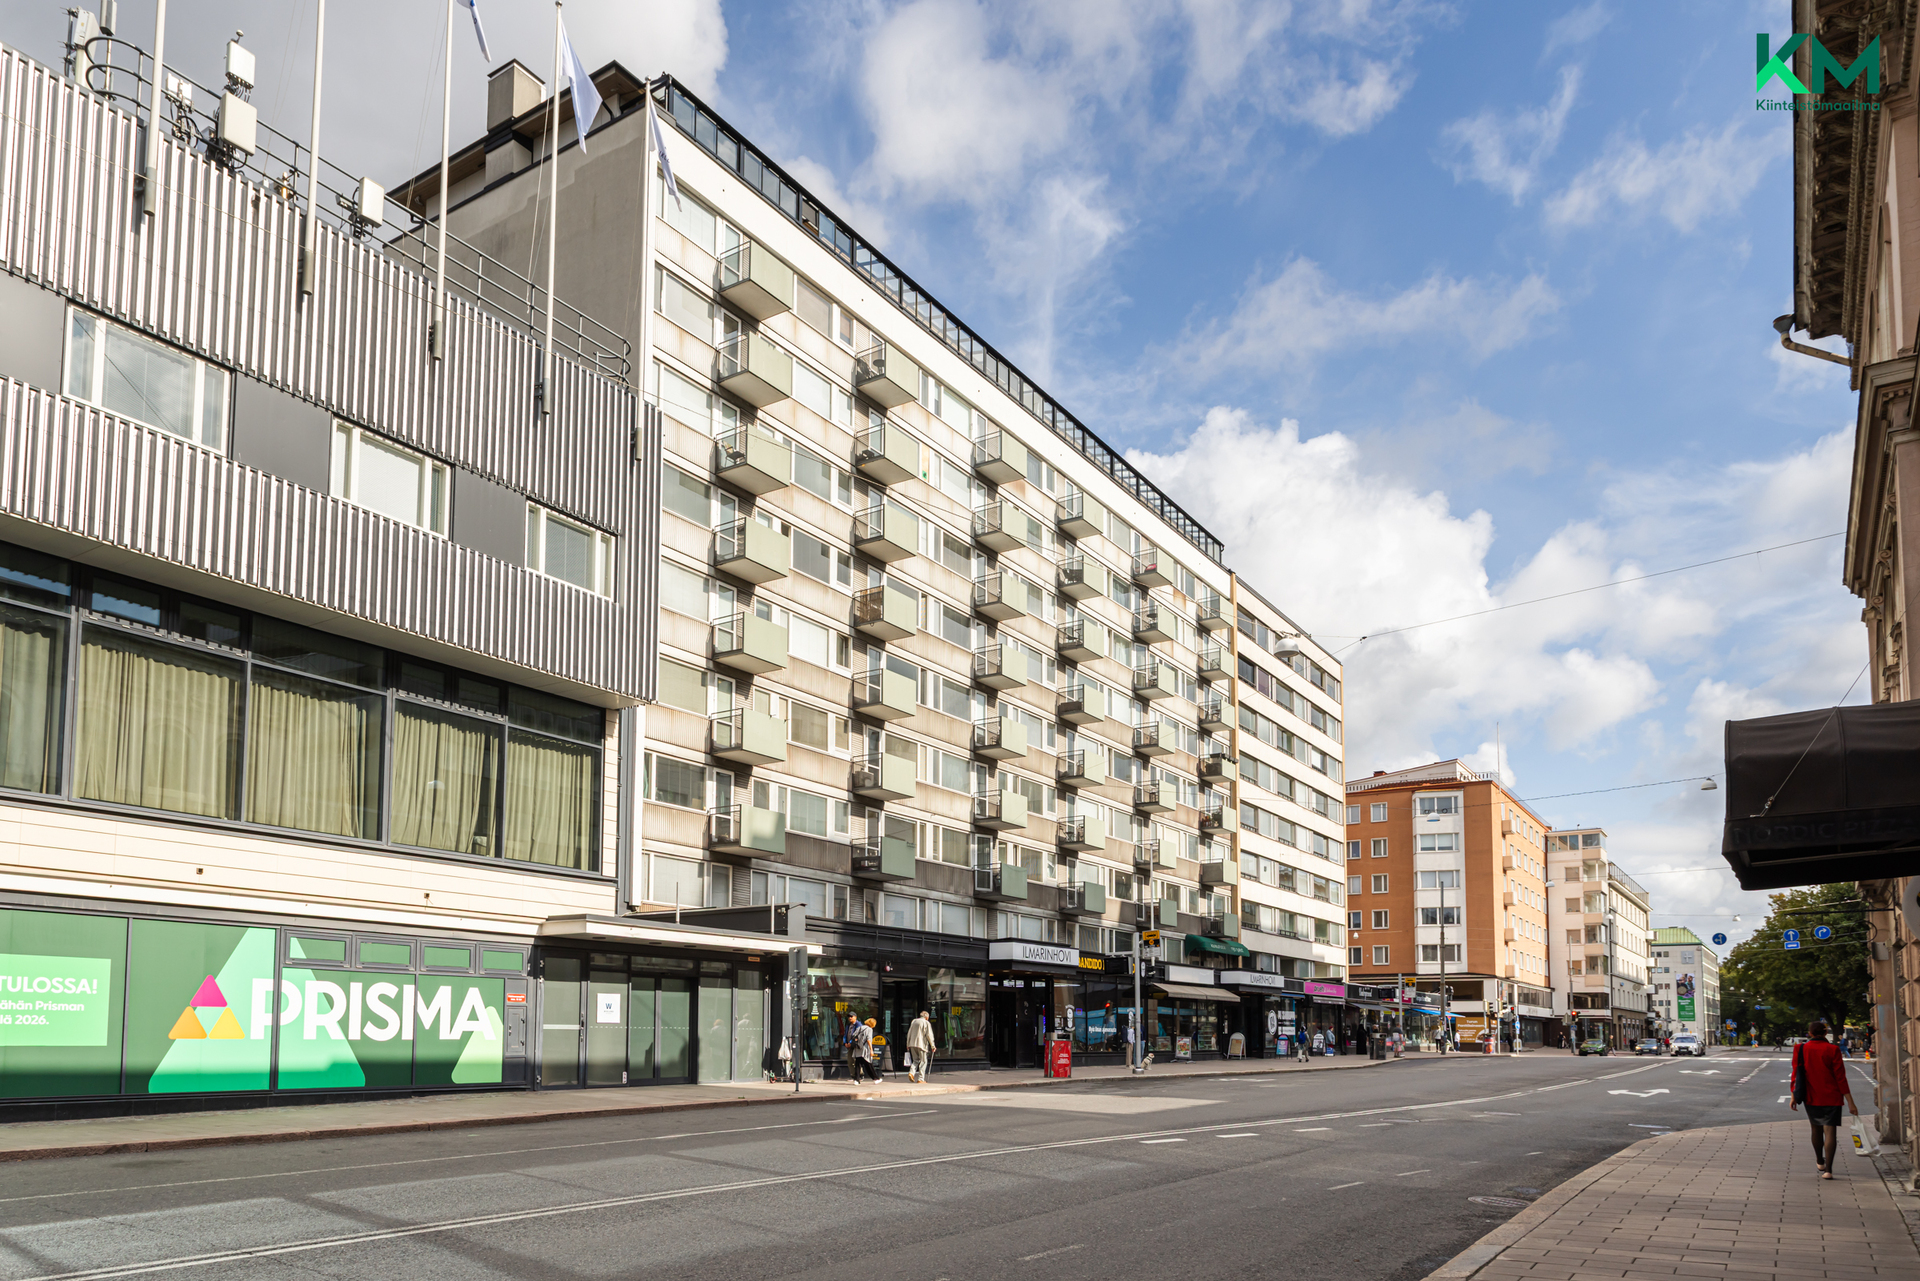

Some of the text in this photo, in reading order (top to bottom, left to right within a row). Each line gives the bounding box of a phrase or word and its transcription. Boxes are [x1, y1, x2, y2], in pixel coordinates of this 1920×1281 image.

[1733, 823, 1835, 845] NORDIC
[1022, 945, 1072, 963] ILMARINHOVI
[35, 1000, 85, 1011] Prisman
[249, 978, 497, 1042] PRISMA
[835, 1001, 849, 1012] UFF
[14, 1014, 50, 1025] 2026.
